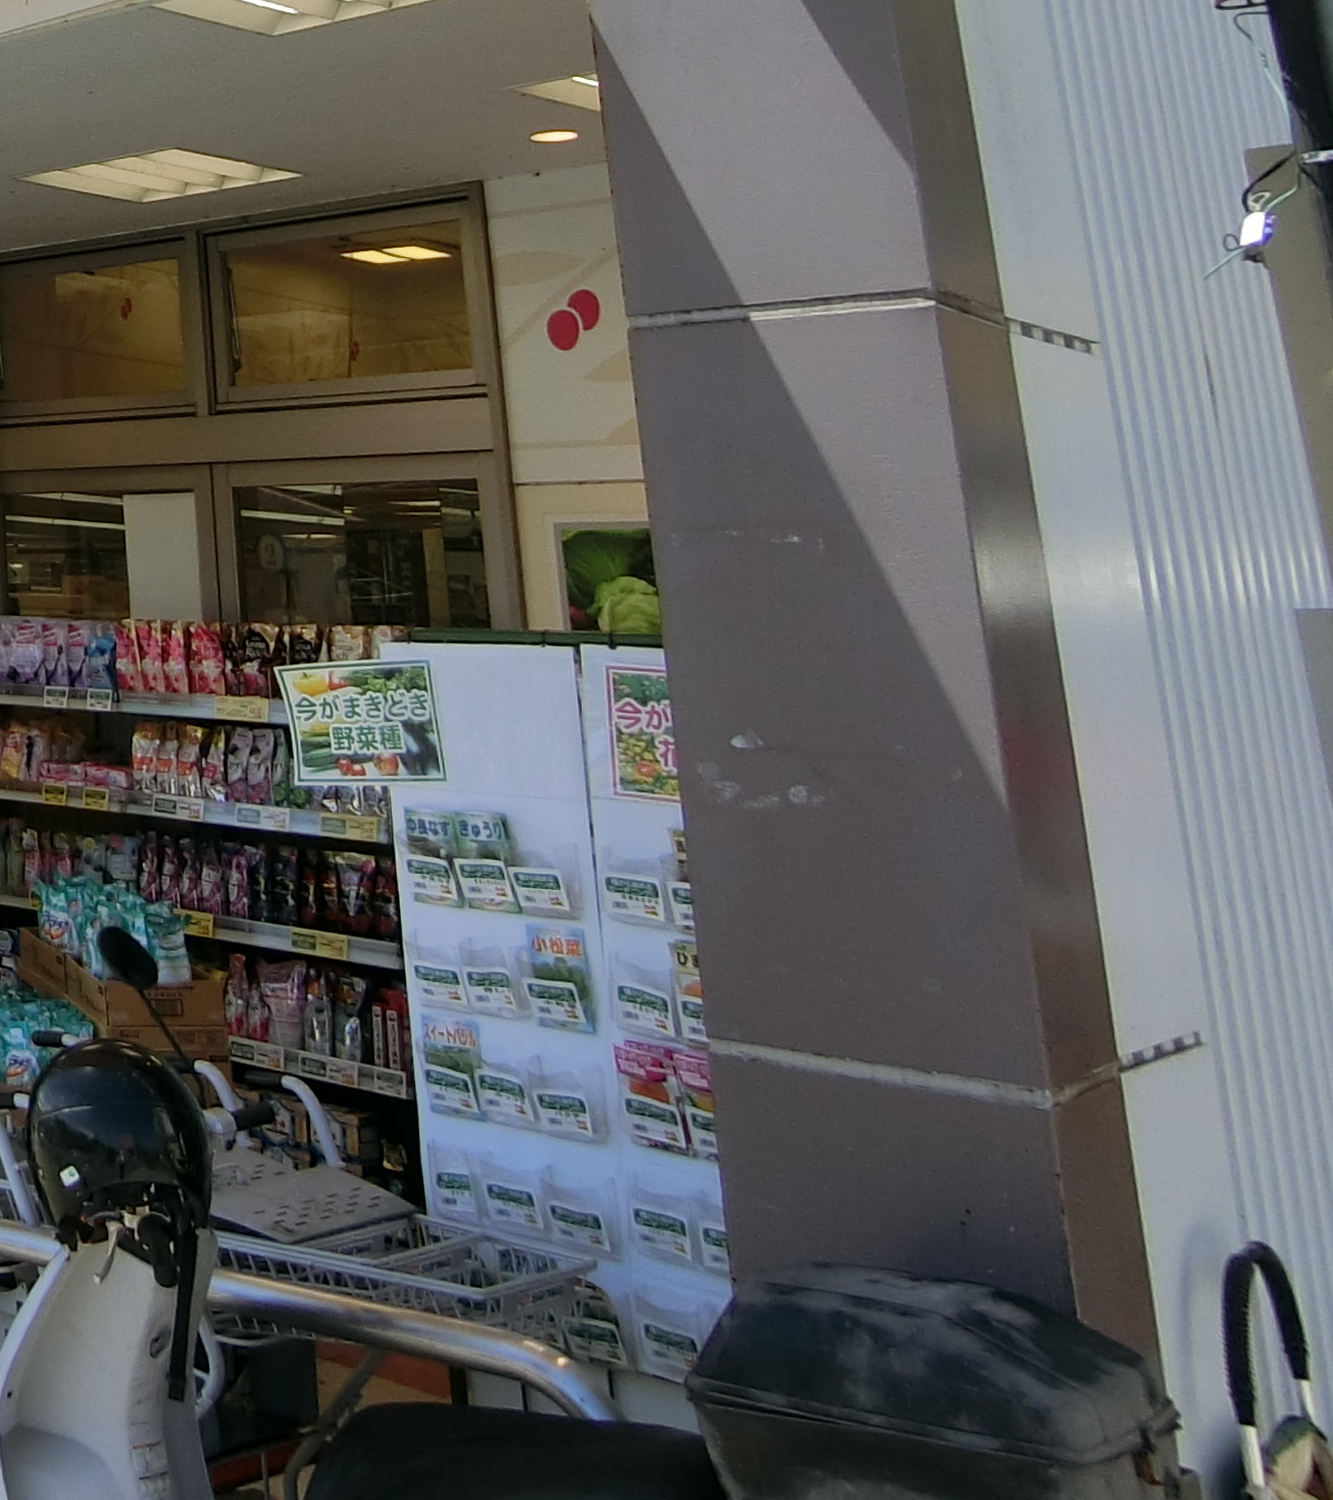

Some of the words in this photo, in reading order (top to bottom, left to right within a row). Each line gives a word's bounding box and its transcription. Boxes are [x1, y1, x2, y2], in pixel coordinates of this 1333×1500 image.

[294, 692, 429, 722] 今がまきどき
[332, 725, 404, 752] 野菜種
[458, 819, 502, 840] きゅうり
[532, 934, 582, 957] 小松菜
